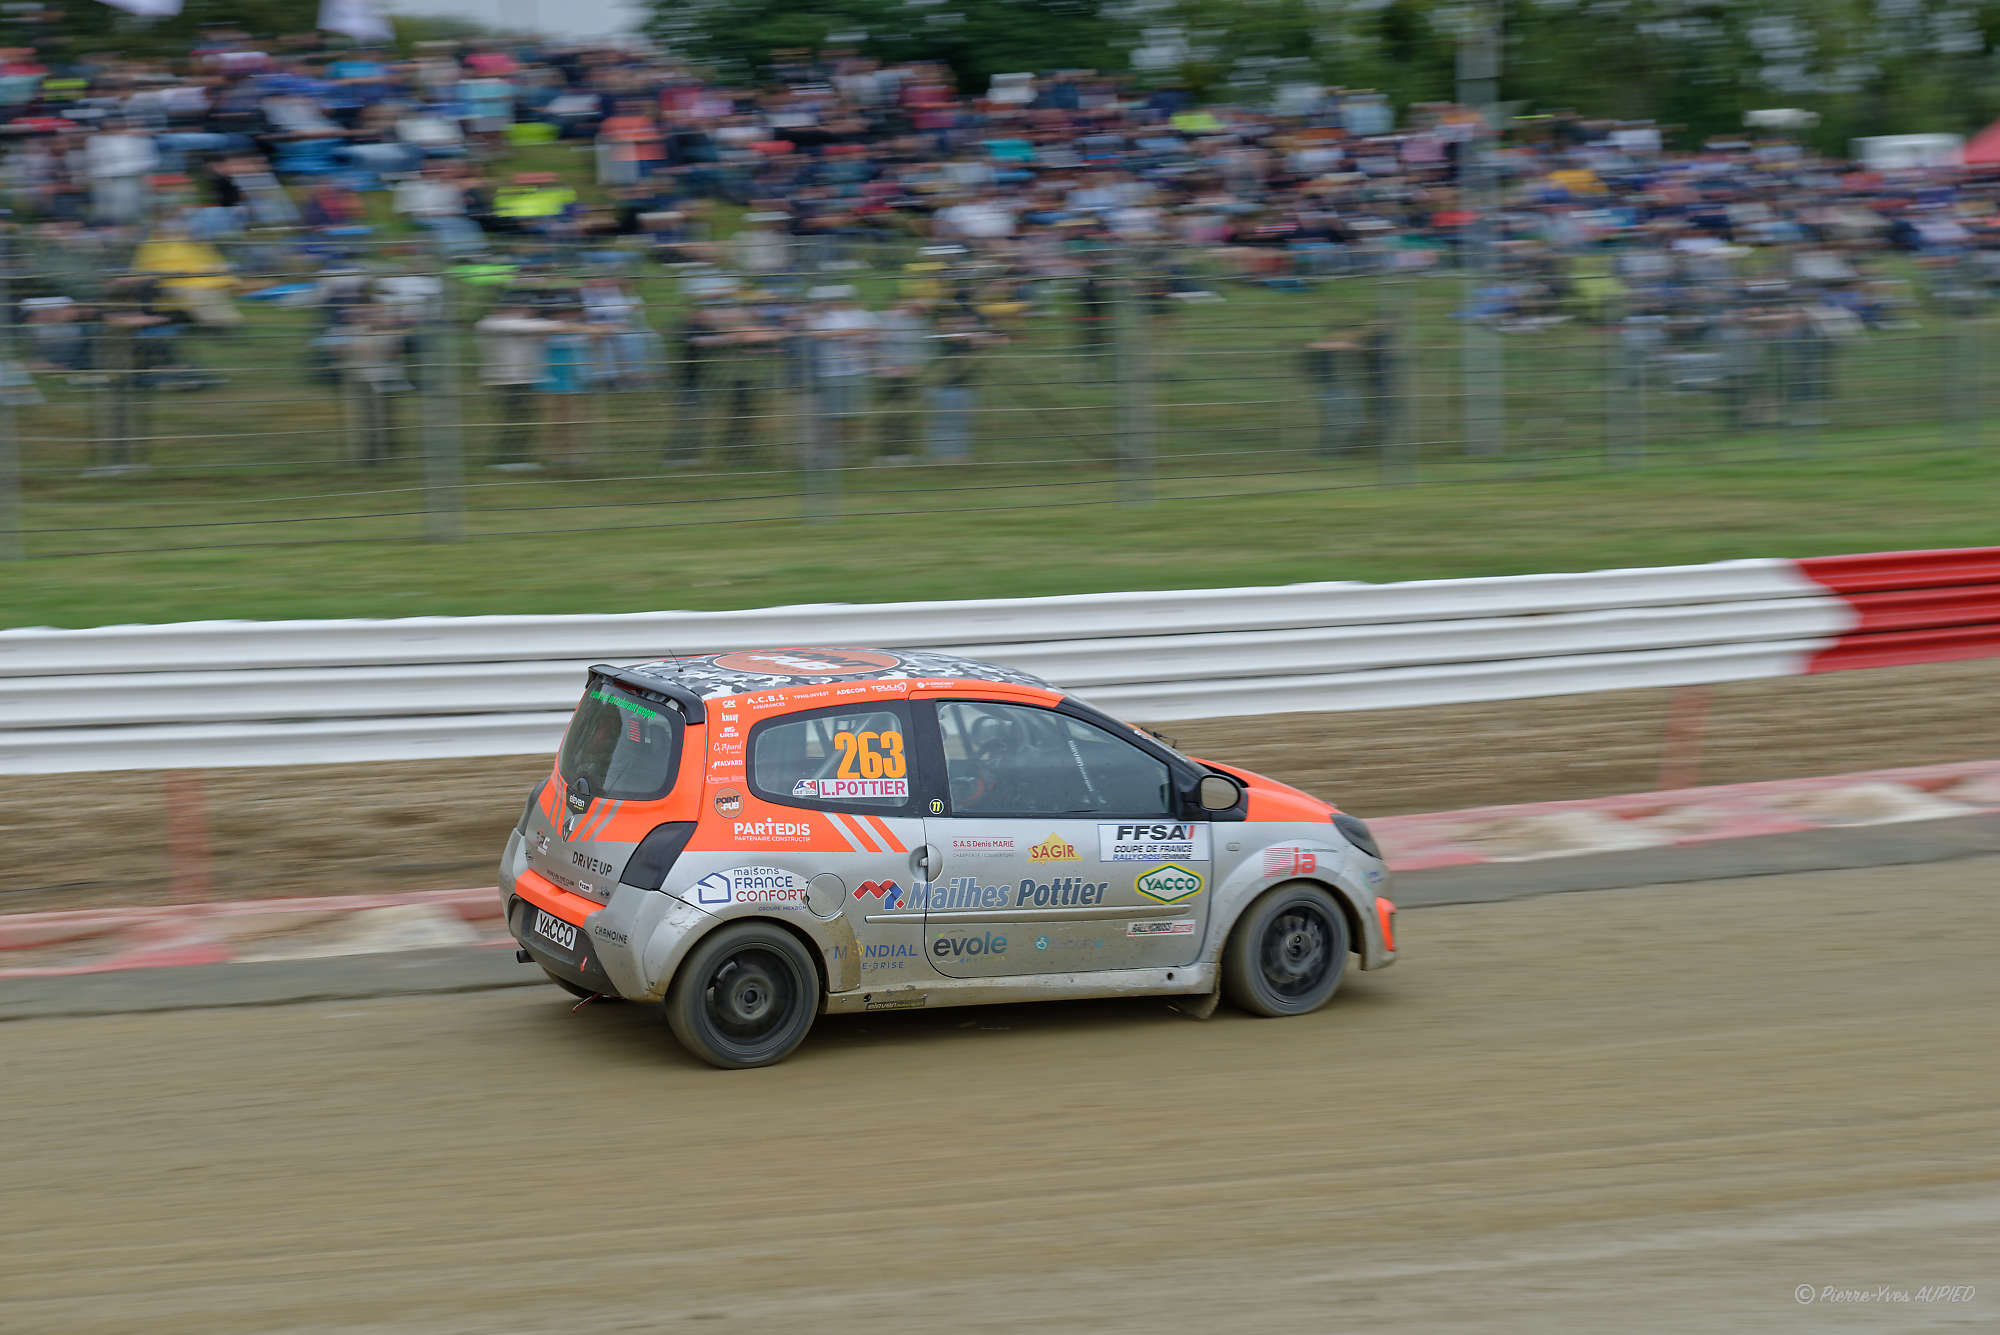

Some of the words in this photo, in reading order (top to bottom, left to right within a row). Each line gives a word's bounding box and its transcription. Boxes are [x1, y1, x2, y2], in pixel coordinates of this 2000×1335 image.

[834, 731, 906, 779] 263
[821, 780, 906, 796] L.POTTIER
[716, 795, 740, 804] POINT
[733, 817, 811, 836] PARTEDIS
[1116, 825, 1186, 840] FFSA
[972, 840, 992, 848] Denis
[992, 840, 1014, 848] MARIE
[1031, 844, 1075, 859] SAGIR
[1113, 845, 1143, 853] COUPE
[1146, 845, 1157, 853] DE
[1158, 845, 1193, 853] FRANCE
[572, 850, 598, 872] DRIVE
[599, 861, 613, 876] UP
[733, 867, 780, 876] maisons
[734, 876, 794, 889] FRANCE
[1144, 877, 1197, 891] YACCO
[735, 889, 805, 903] CONFORT
[906, 877, 1010, 911] Mailhes
[1015, 877, 1110, 908] Pottier
[539, 912, 574, 948] YACCO
[594, 926, 629, 945] CHANOINE
